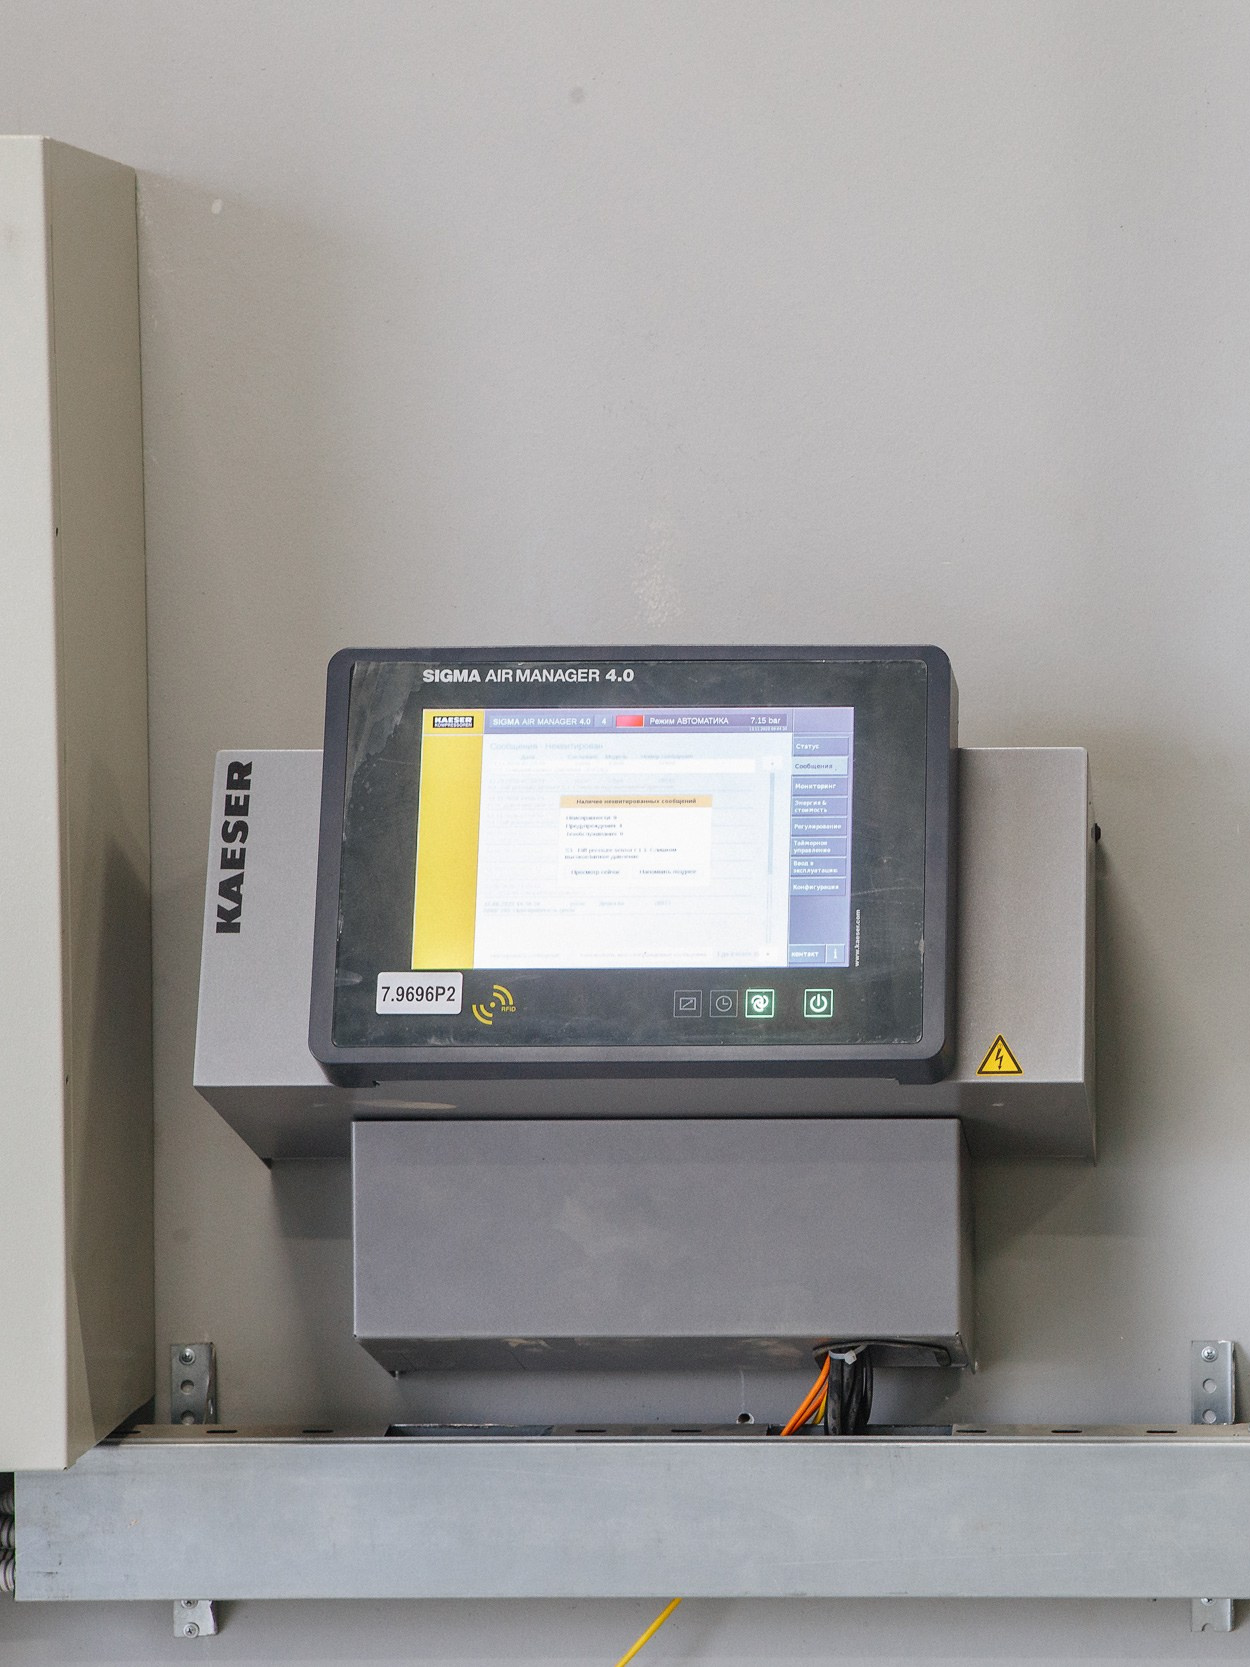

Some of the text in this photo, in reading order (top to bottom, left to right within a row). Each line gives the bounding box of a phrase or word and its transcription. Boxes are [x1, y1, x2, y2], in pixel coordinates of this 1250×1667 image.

[422, 668, 635, 683] SIGMA AIR MANAGER 4.0
[492, 718, 520, 726] SIGMA
[537, 718, 577, 726] MANAGER
[579, 717, 591, 725] 4.0
[601, 717, 607, 725] 4
[649, 716, 729, 725] Режим АВТОМАТИКА
[768, 716, 781, 724] bar
[795, 743, 820, 751] Статус
[795, 783, 837, 791] Мониторинг
[216, 760, 252, 934] KAESER
[381, 986, 456, 1002] 7.9696P2
